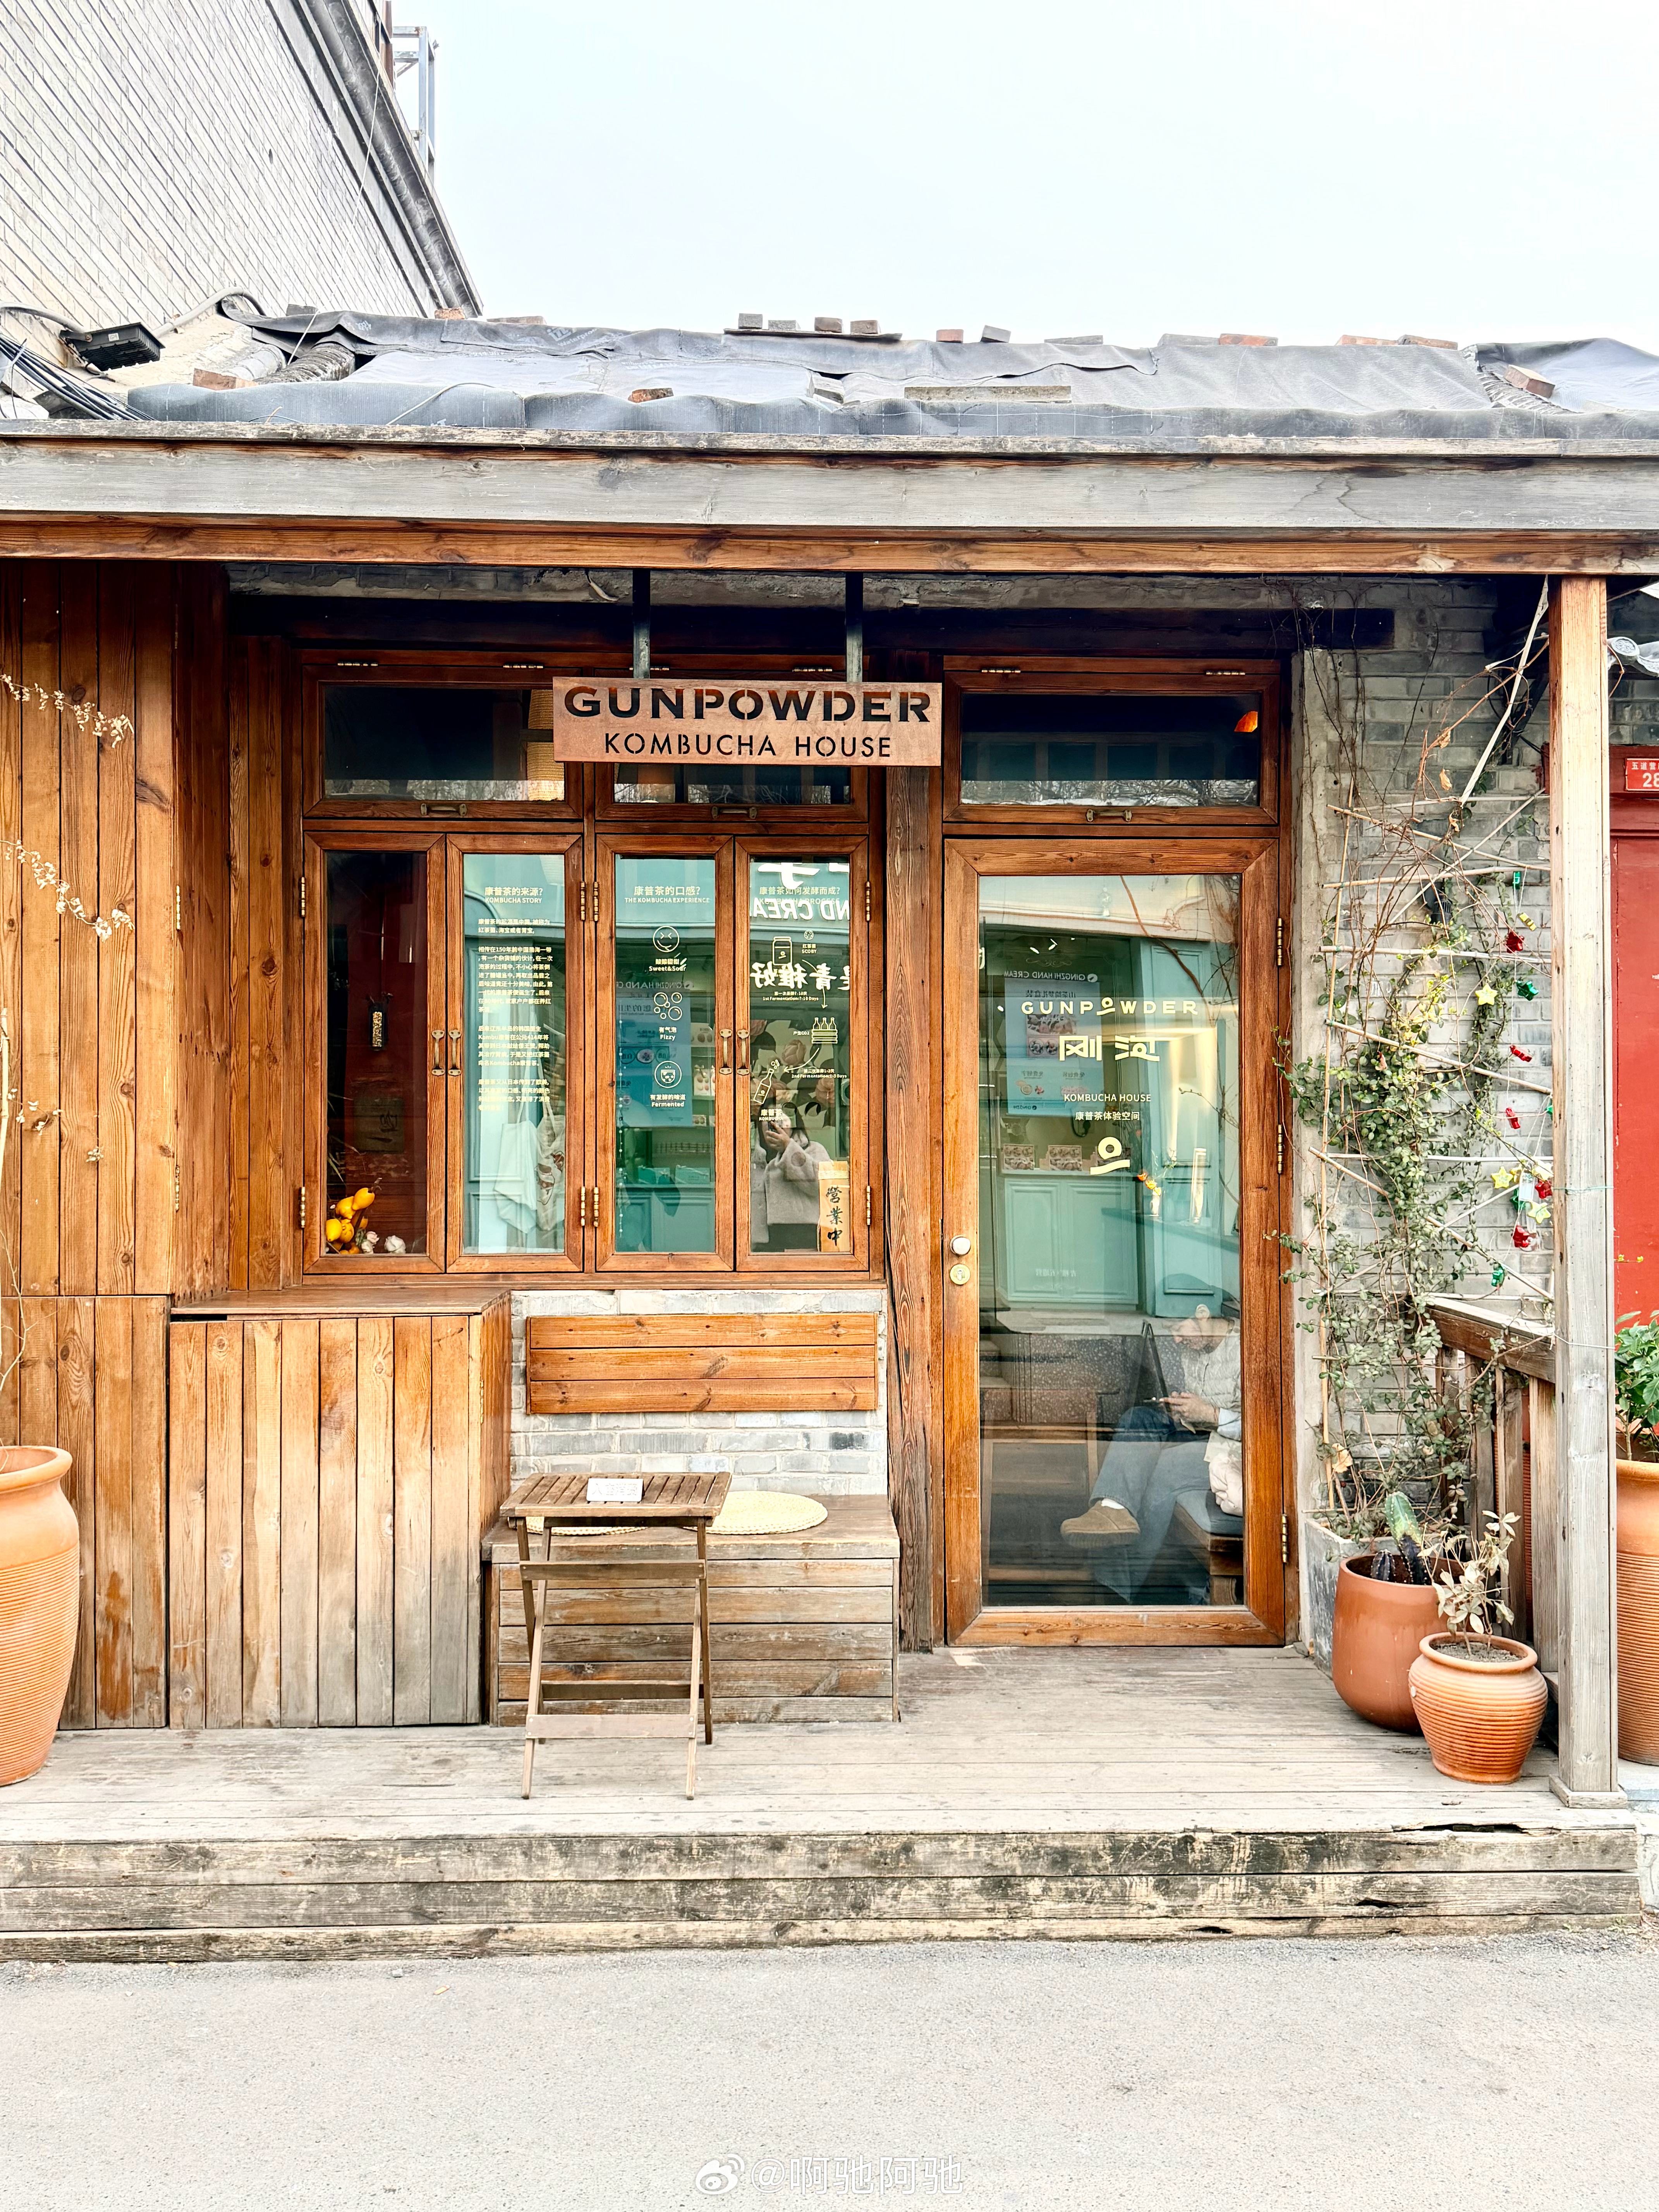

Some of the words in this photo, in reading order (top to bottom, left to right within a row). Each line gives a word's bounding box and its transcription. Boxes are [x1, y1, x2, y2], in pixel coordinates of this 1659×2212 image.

[565, 686, 930, 722] GUNPOWDER
[605, 733, 776, 757] KOMBUCHA
[796, 736, 890, 757] HOUSE
[484, 887, 543, 896] 康普茶的来源?
[634, 886, 701, 896] 康普茶的口感?
[759, 887, 840, 895] 康普茶如何发酵而成?
[1075, 1111, 1140, 1121] 康普茶体验空间
[826, 1186, 843, 1246] 營業中
